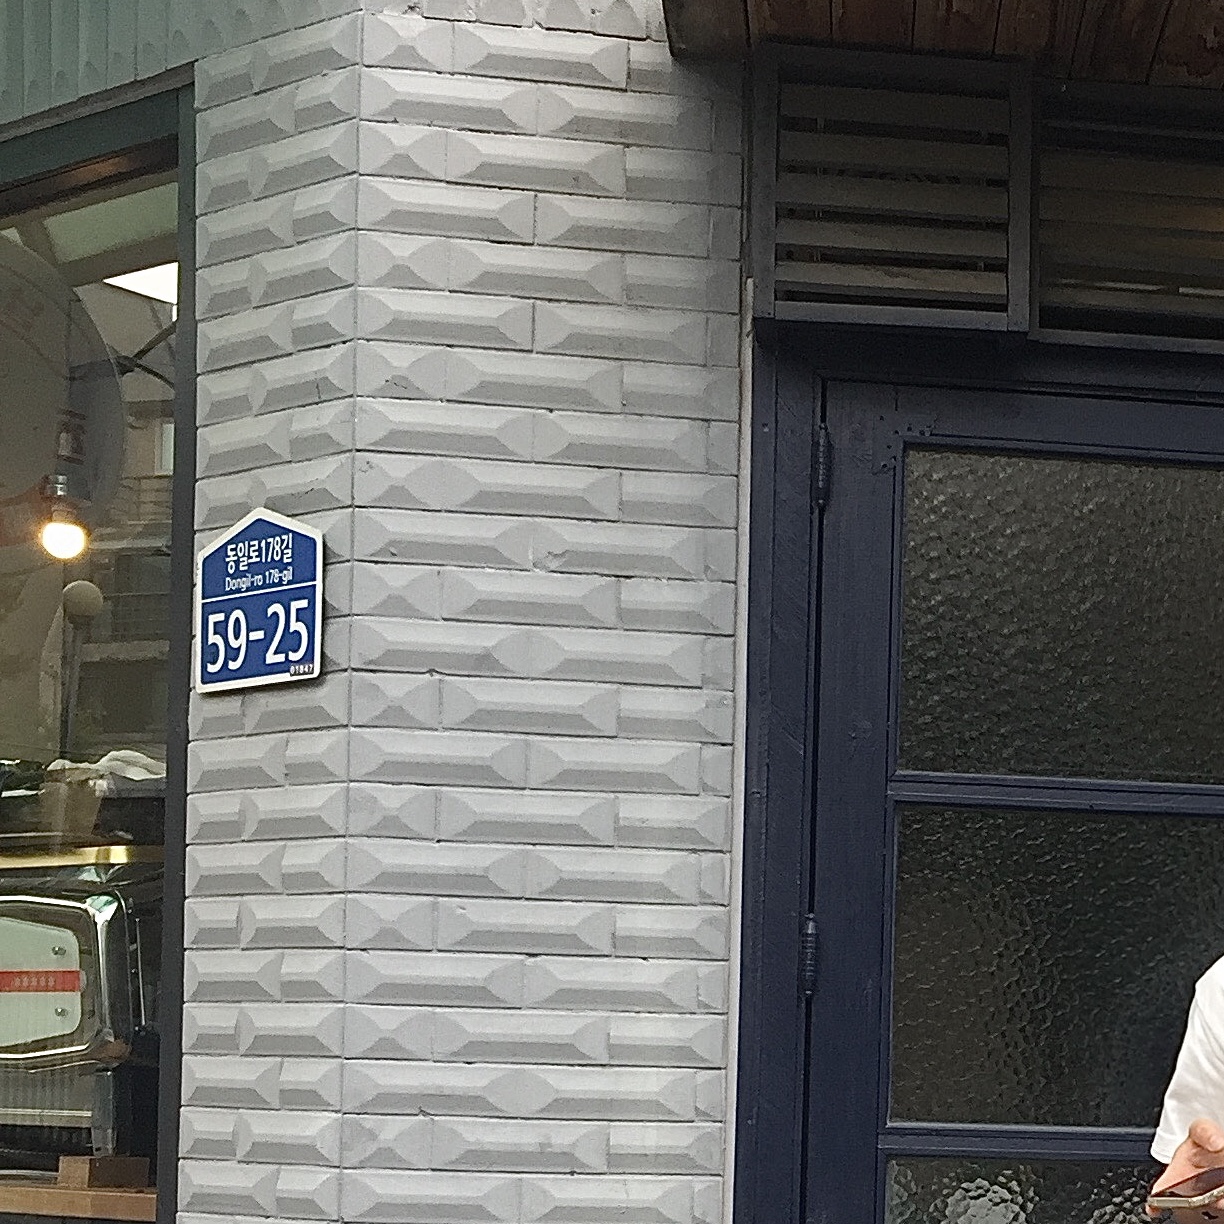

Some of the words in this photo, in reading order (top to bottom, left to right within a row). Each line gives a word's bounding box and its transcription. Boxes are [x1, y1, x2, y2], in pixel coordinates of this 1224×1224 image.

[225, 532, 293, 574] 동일로178길
[225, 573, 264, 591] Dongil-ro
[265, 566, 293, 584] 178-gil
[206, 599, 309, 673] 59-25
